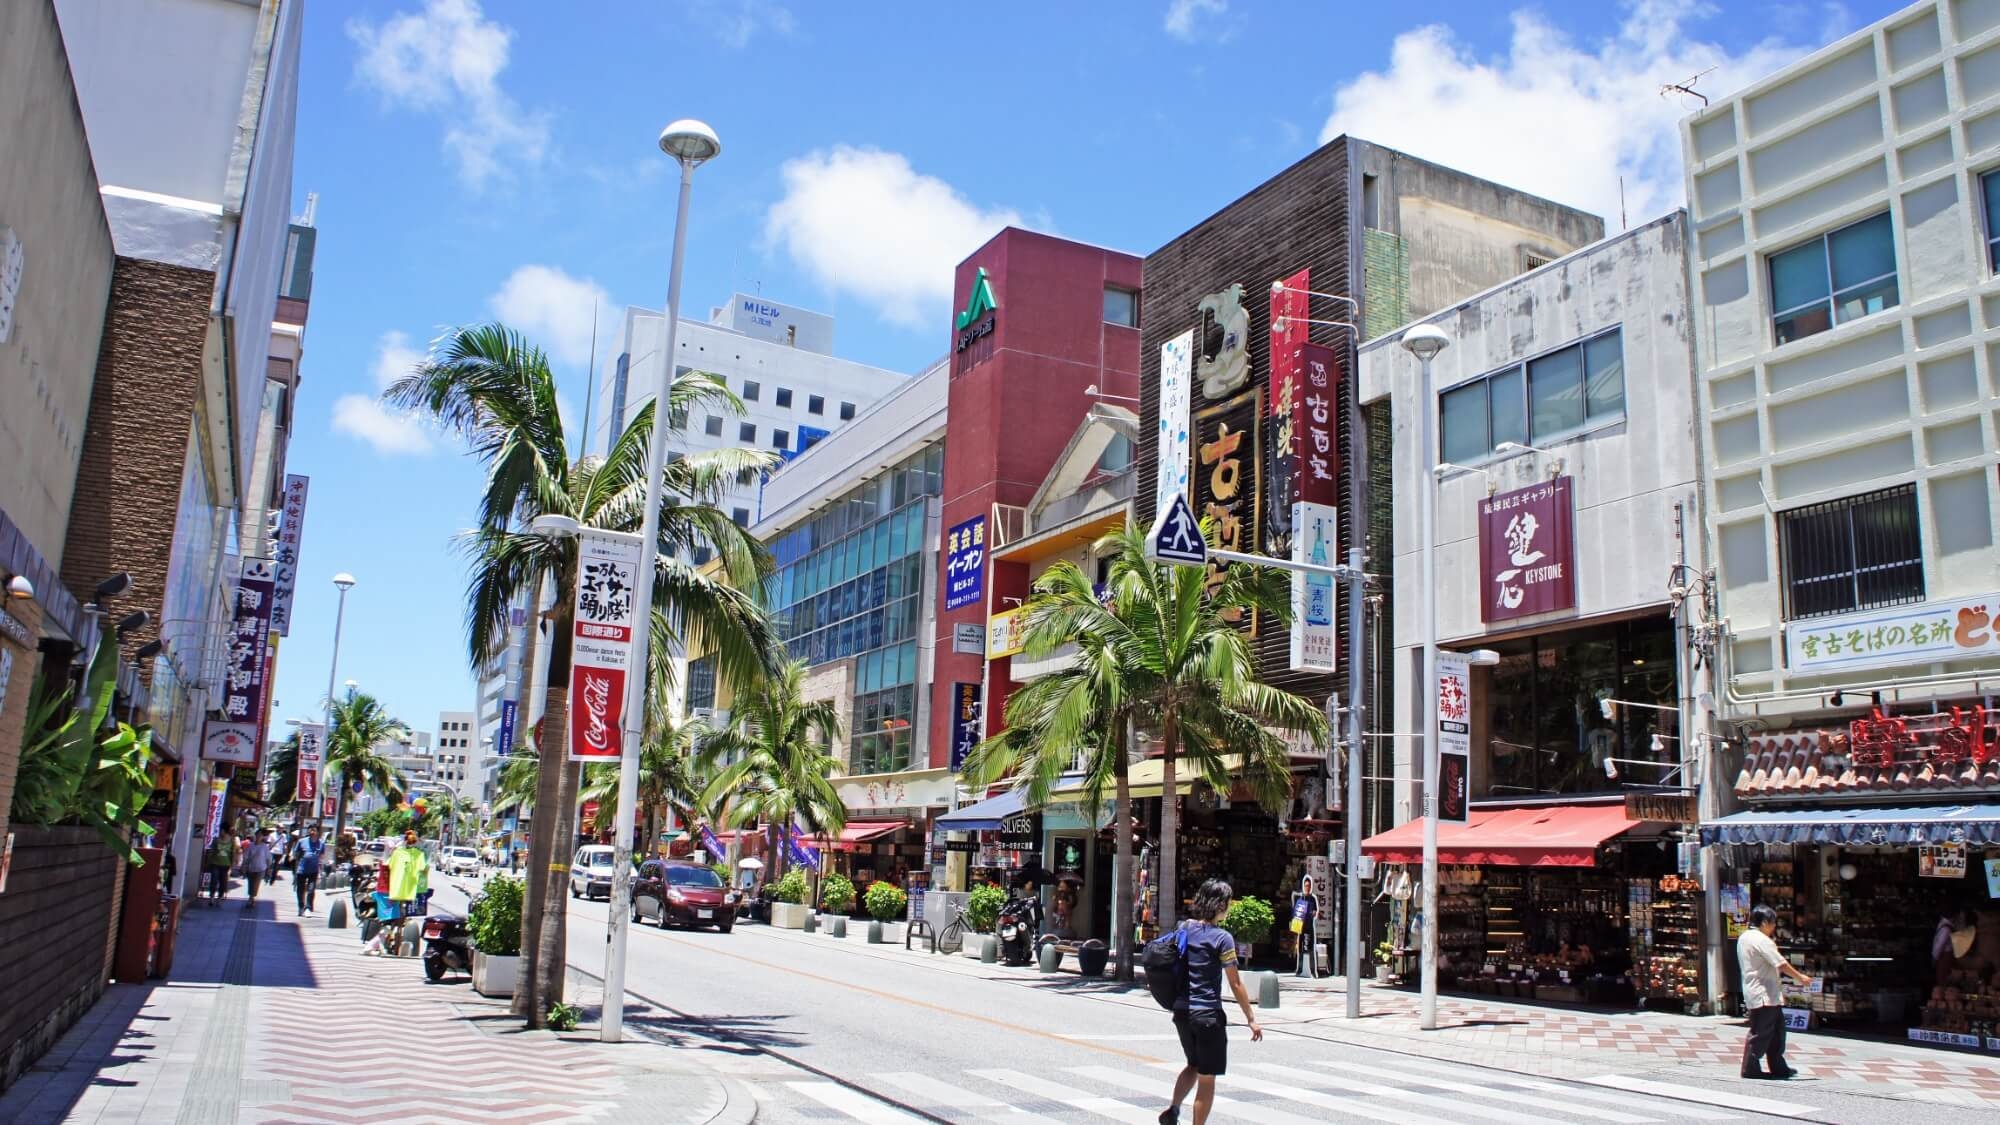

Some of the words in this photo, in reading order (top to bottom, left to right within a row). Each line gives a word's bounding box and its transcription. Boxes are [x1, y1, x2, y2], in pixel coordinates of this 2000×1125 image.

[1484, 485, 1564, 515] 琉球民芸ギャラリー
[949, 522, 984, 555] 英会話
[585, 562, 628, 577] 一万人の
[948, 549, 983, 577] イーオン
[1525, 562, 1562, 585] KEYSTONE
[272, 547, 296, 624] あんがま
[582, 575, 631, 598] エイサー
[225, 588, 262, 716] 御菓子御殿
[1801, 618, 1953, 660] 宮古そばの名所
[584, 673, 609, 750] Coca-Cola
[1635, 797, 1691, 821] KEYSTONE
[1002, 819, 1031, 834] SILVERS
